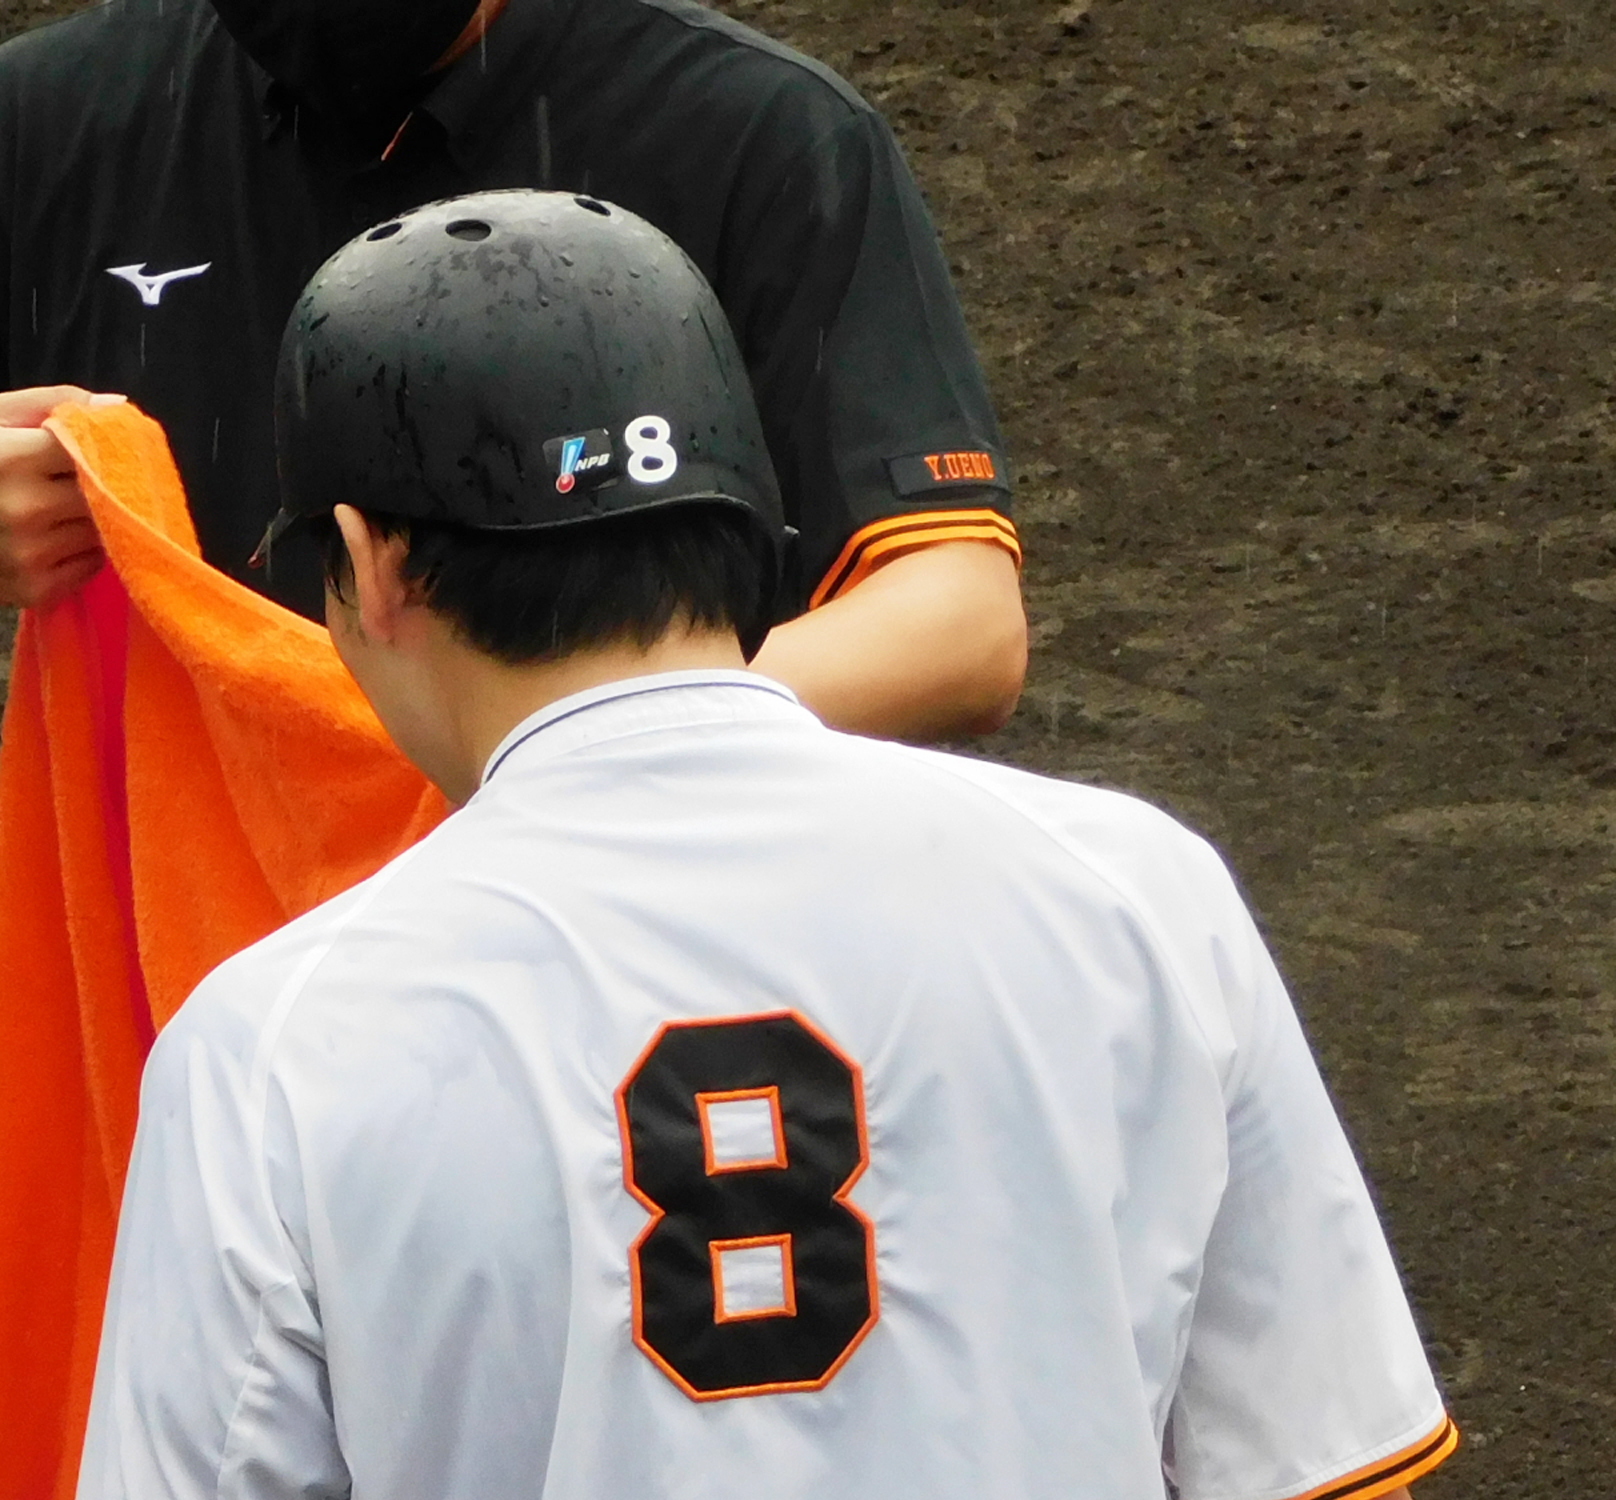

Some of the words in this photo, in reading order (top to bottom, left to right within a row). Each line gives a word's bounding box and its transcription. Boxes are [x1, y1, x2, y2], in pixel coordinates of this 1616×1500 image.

[575, 453, 610, 471] NPB
[625, 415, 677, 483] 8
[614, 1008, 880, 1403] 8
